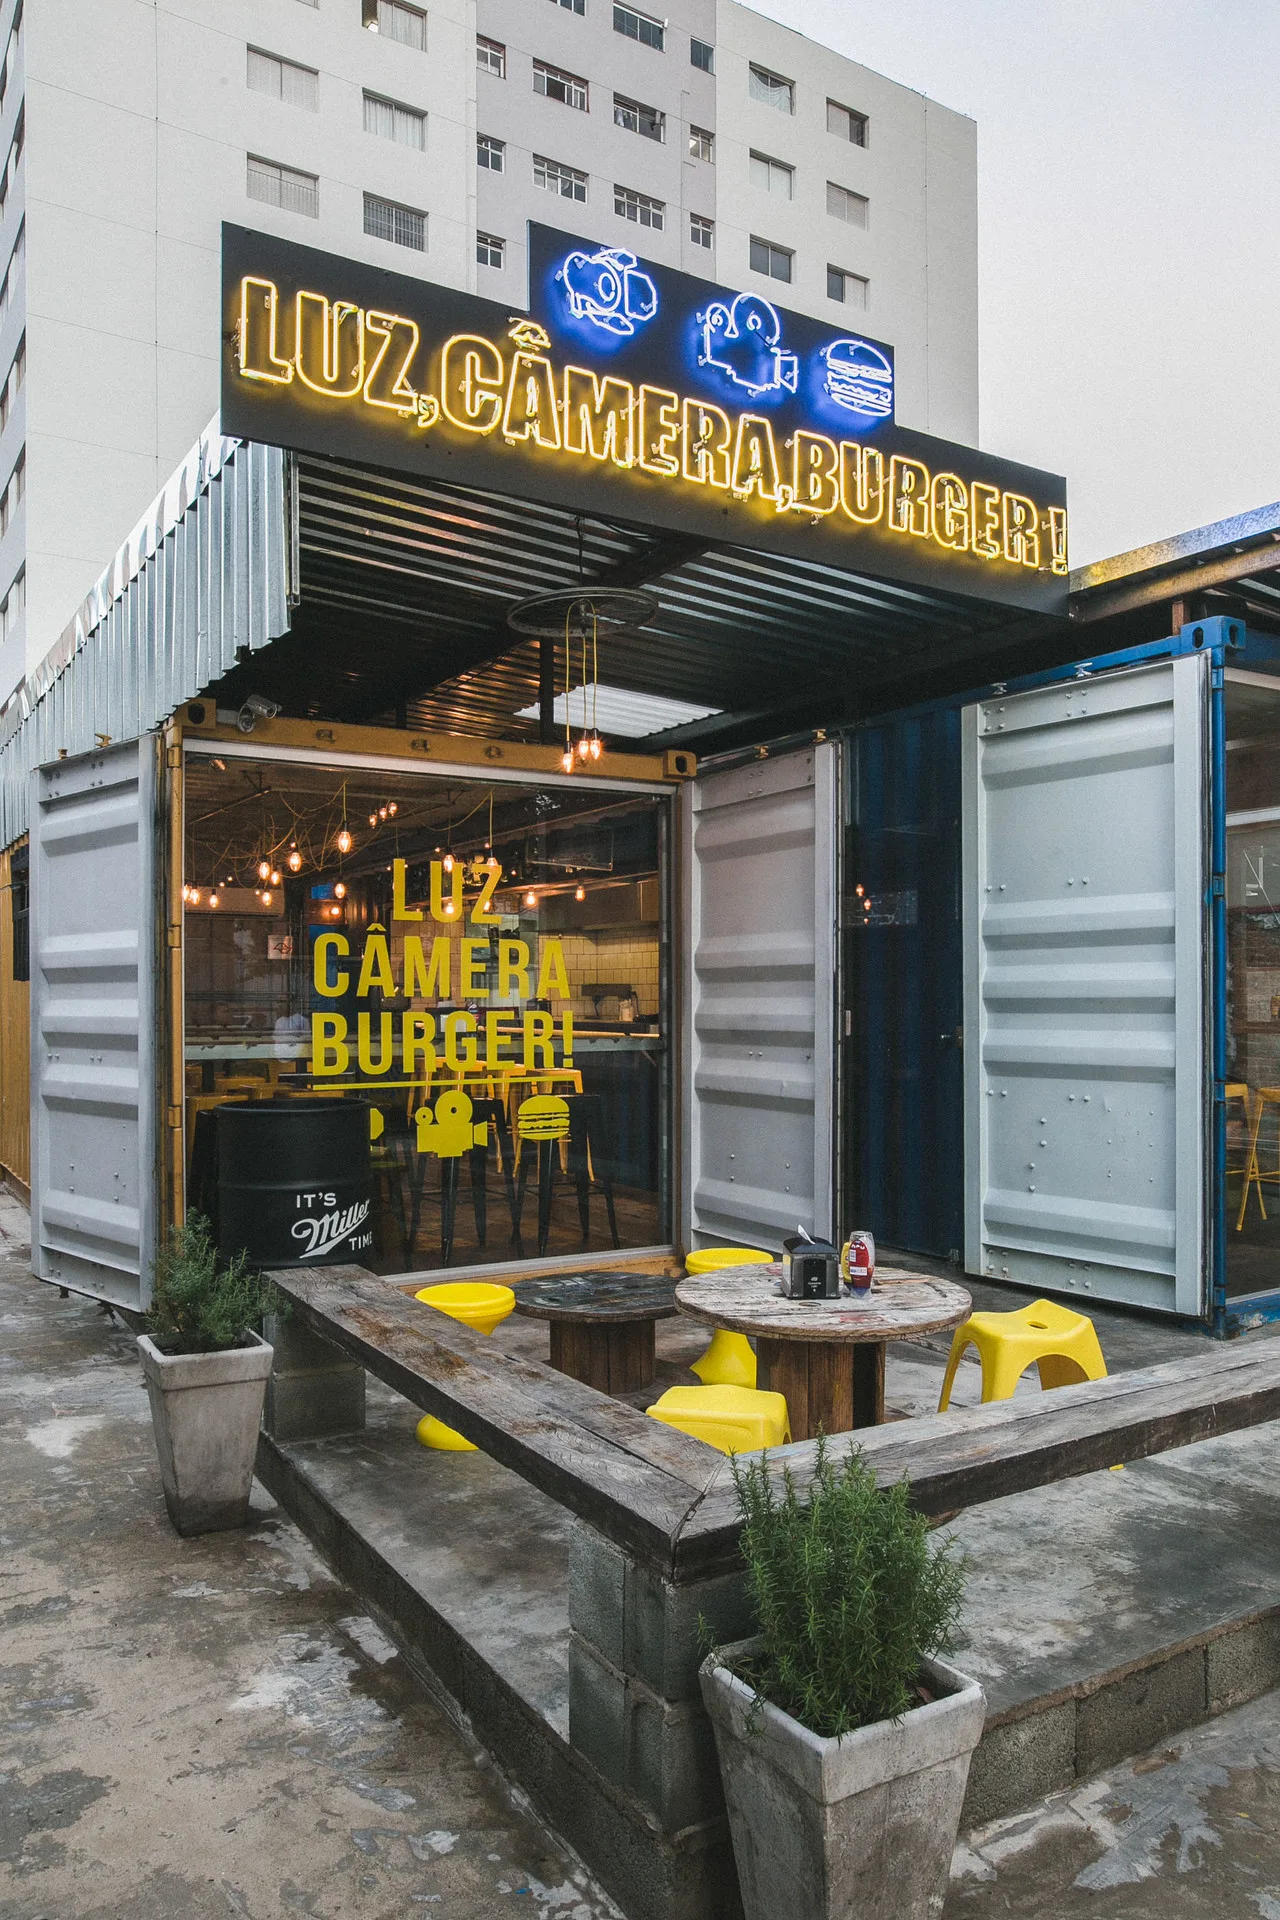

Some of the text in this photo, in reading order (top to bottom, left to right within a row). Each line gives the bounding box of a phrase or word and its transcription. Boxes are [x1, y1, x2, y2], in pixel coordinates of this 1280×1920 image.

[239, 275, 439, 428] LUZ,
[392, 858, 503, 924] LUZ
[313, 923, 572, 999] CÂMERA
[311, 1010, 574, 1077] BURGER!
[291, 1198, 371, 1258] Miller
[296, 1192, 337, 1209] IT'S
